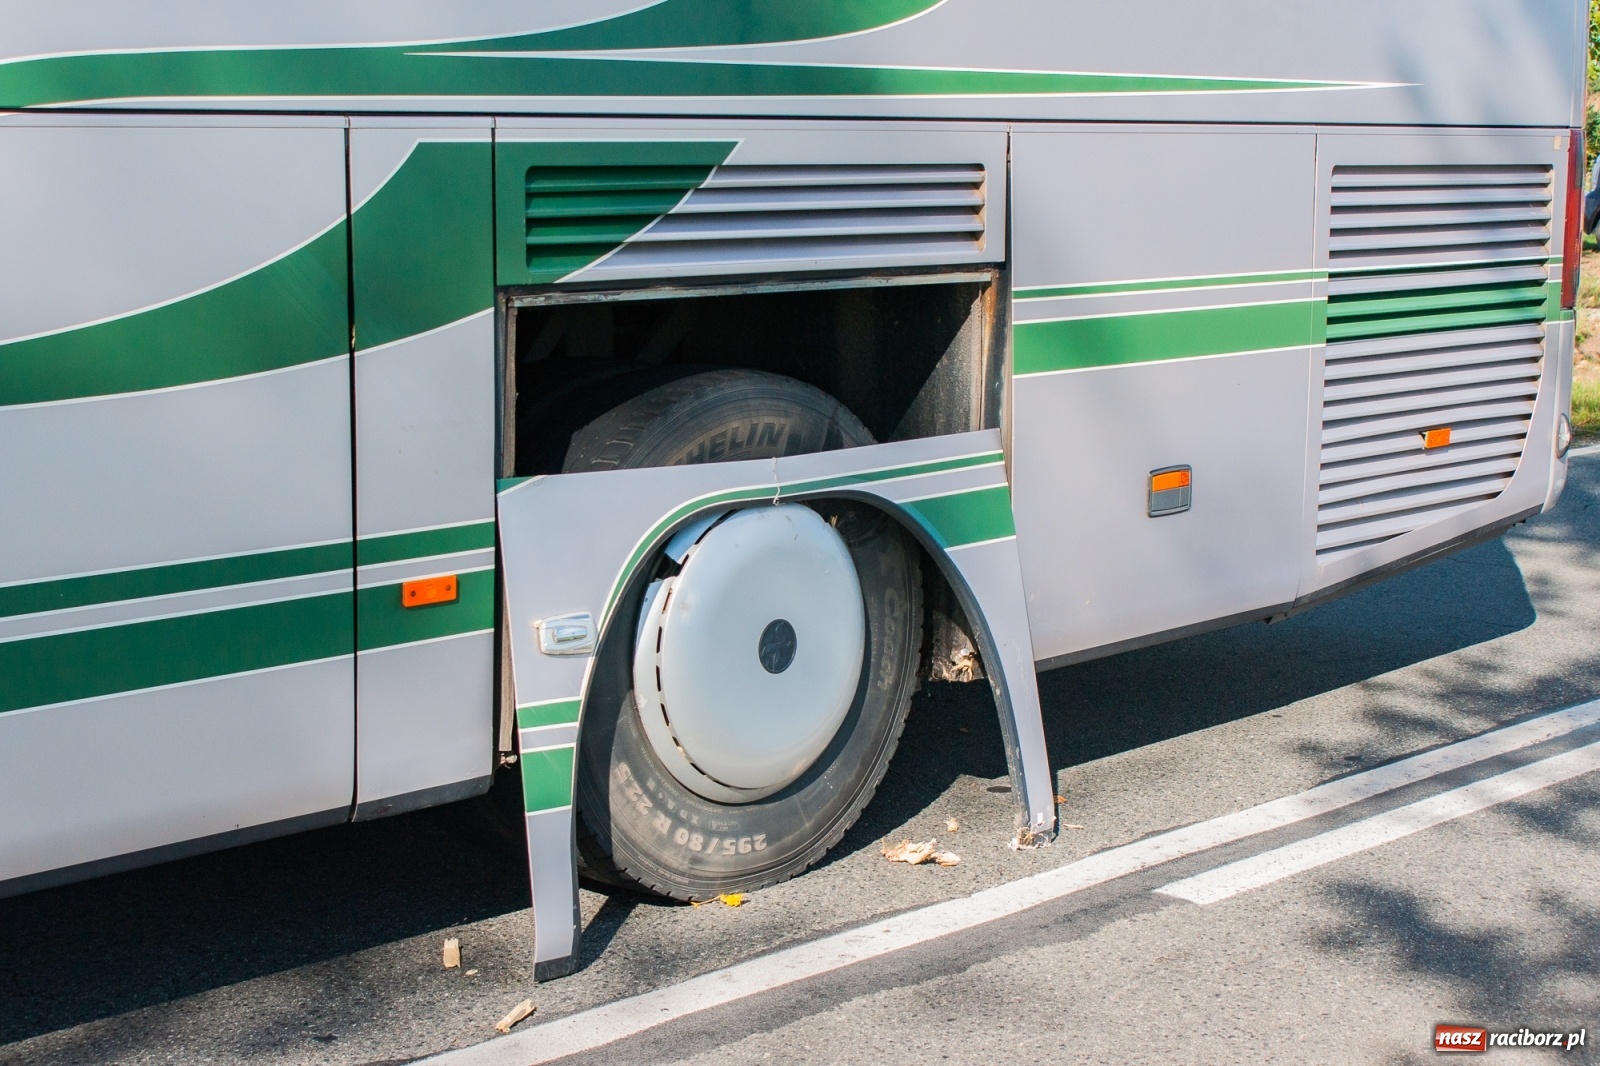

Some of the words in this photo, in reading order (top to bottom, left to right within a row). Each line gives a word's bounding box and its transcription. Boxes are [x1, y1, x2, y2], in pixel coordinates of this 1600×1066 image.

[675, 422, 787, 465] HELIN
[614, 762, 653, 816] 22.5
[652, 810, 672, 834] R
[674, 828, 767, 856] 295/80
